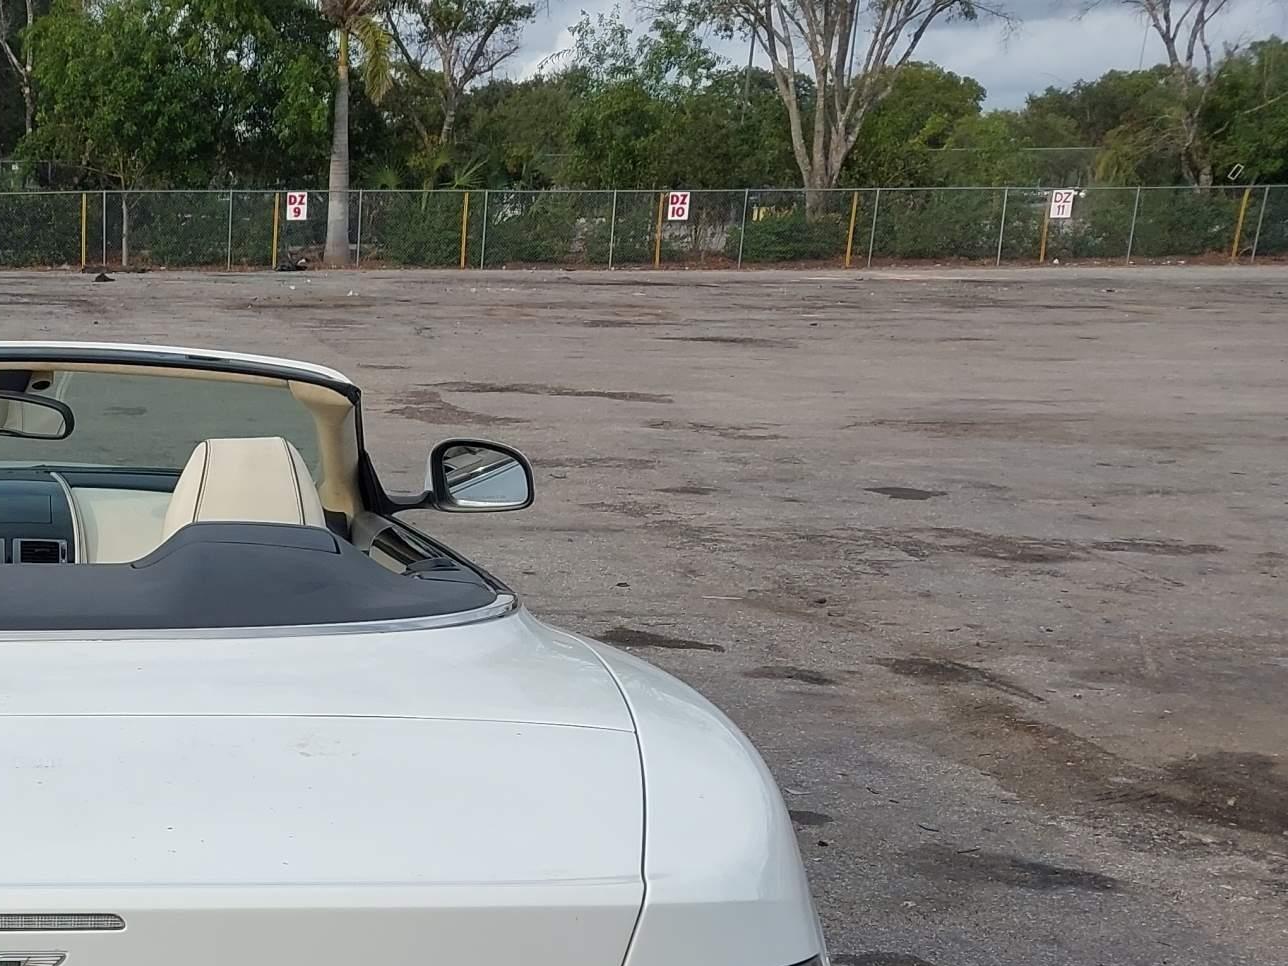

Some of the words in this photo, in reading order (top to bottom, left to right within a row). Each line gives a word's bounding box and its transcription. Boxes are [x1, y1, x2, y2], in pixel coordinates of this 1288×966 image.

[288, 194, 305, 205] DZ
[670, 194, 688, 205] DZ
[1054, 192, 1072, 203] DZ
[293, 207, 301, 217] 9
[671, 207, 685, 217] 10
[1057, 205, 1065, 215] 11
